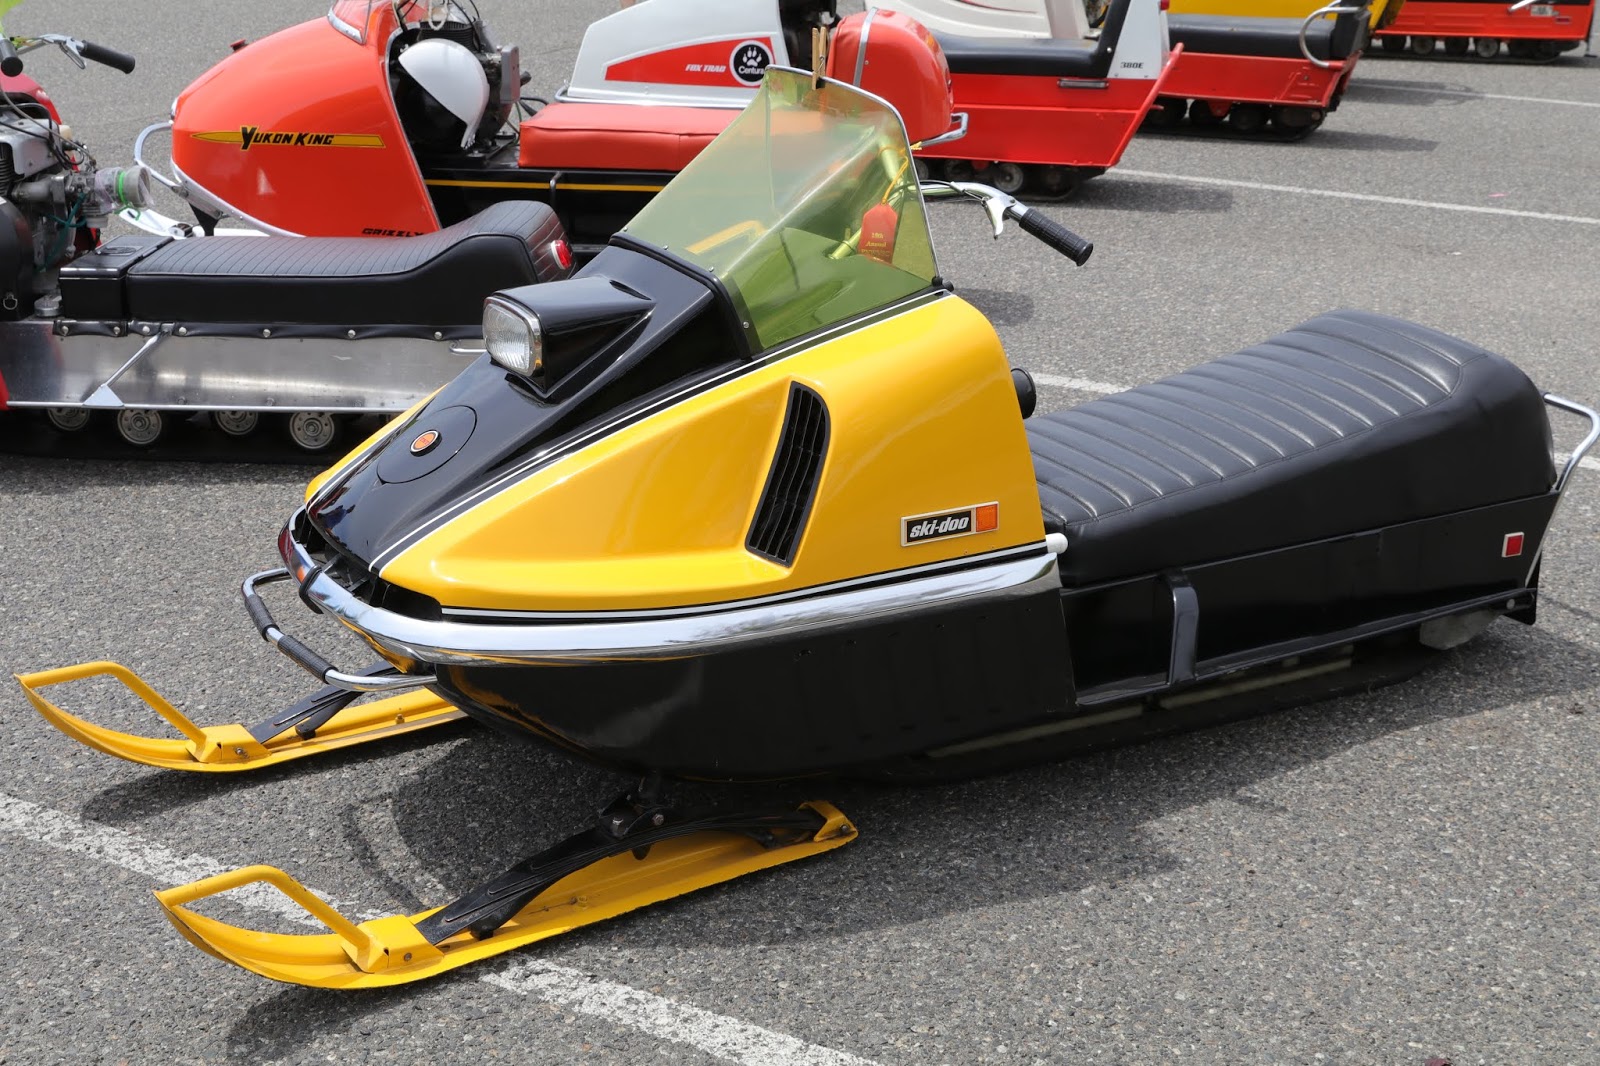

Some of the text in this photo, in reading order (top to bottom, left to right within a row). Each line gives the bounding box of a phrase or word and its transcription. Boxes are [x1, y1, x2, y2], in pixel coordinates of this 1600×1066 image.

[684, 63, 703, 73] FOX
[240, 126, 335, 151] YUKON KING
[909, 516, 970, 539] ski-doo
